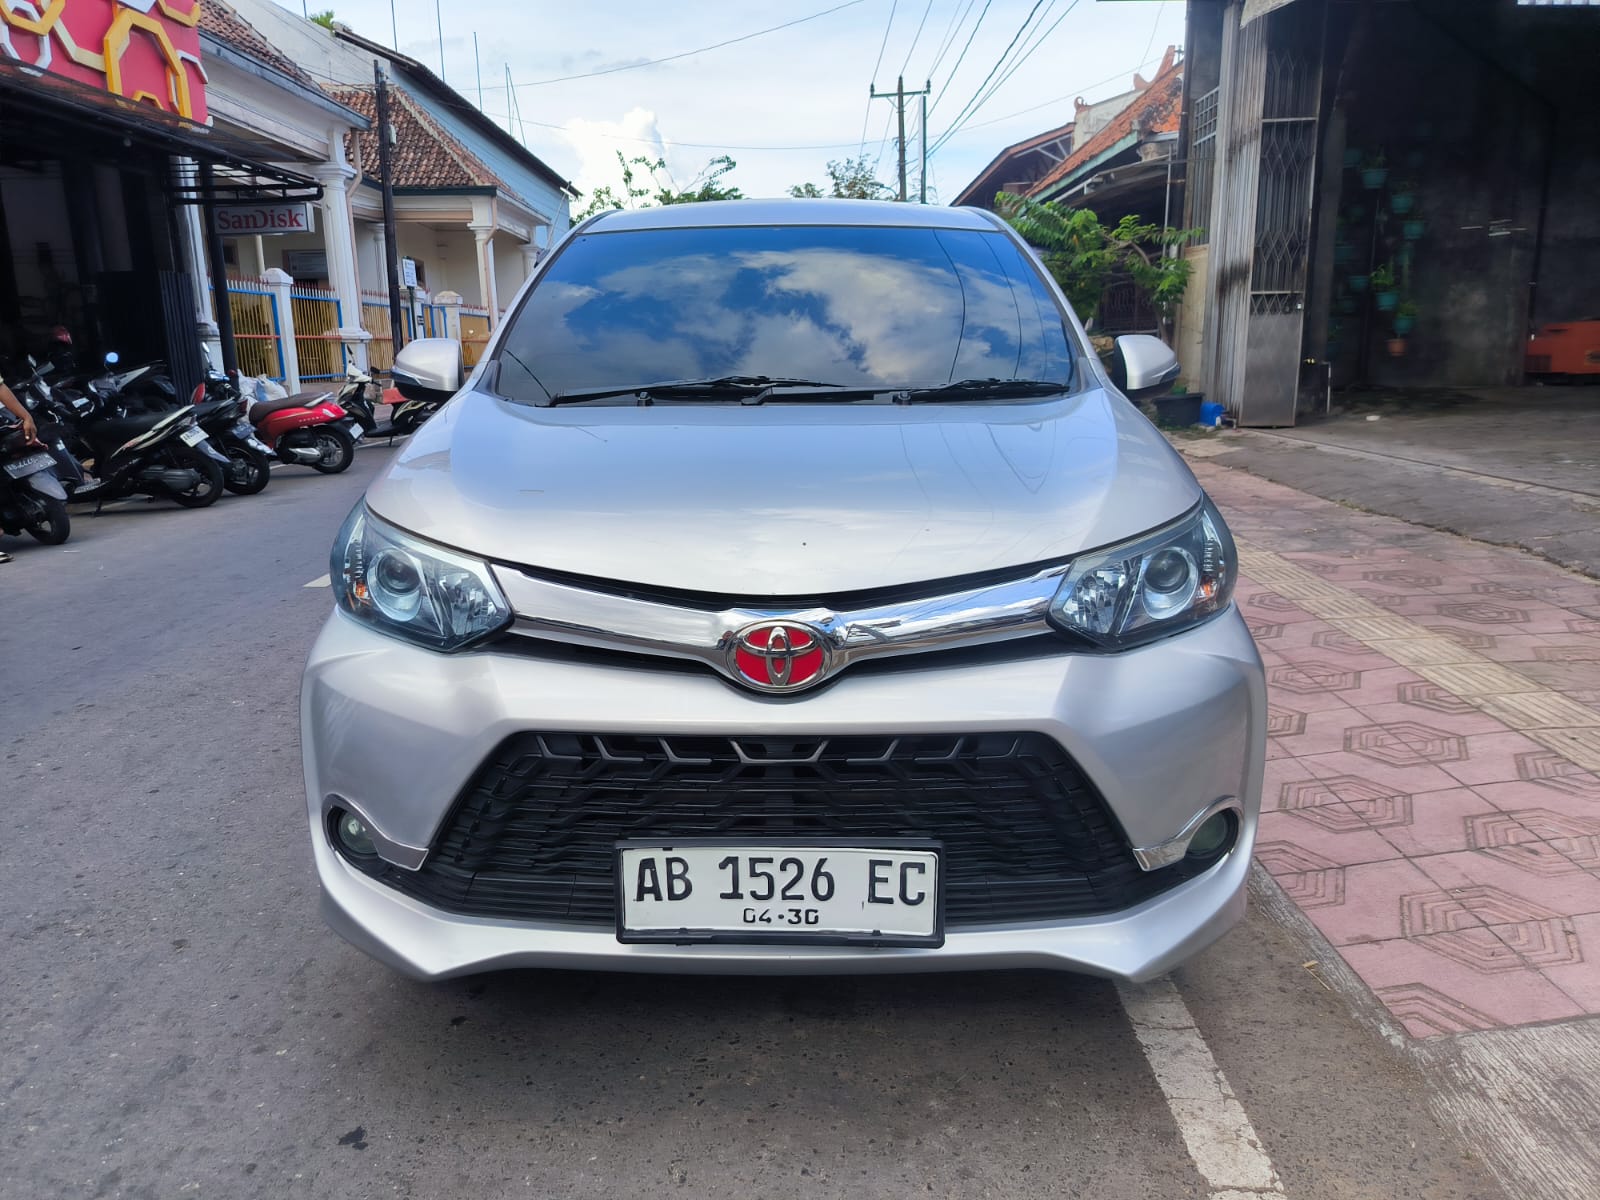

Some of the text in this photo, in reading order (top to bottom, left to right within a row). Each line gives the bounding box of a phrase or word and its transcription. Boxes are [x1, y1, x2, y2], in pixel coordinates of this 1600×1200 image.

[217, 208, 304, 230] SanDisk
[635, 856, 926, 906] AB 1526 EC
